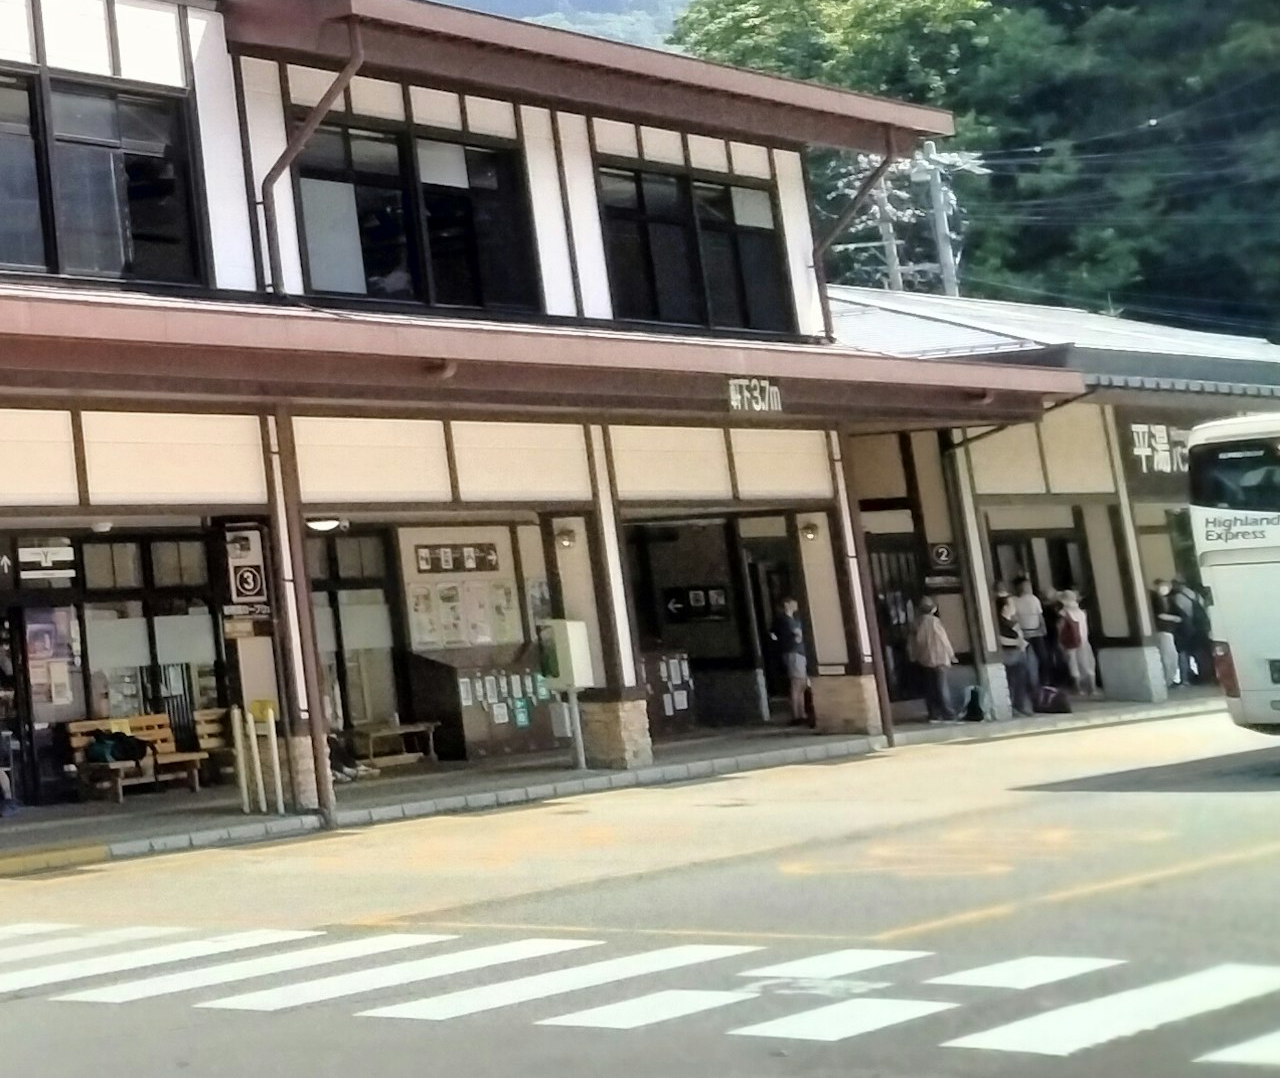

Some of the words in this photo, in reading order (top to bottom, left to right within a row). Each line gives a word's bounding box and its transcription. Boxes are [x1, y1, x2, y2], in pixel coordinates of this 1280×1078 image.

[1205, 515, 1280, 531] Highland
[1205, 530, 1267, 543] Express
[937, 547, 949, 561] 2
[243, 571, 255, 590] 3
